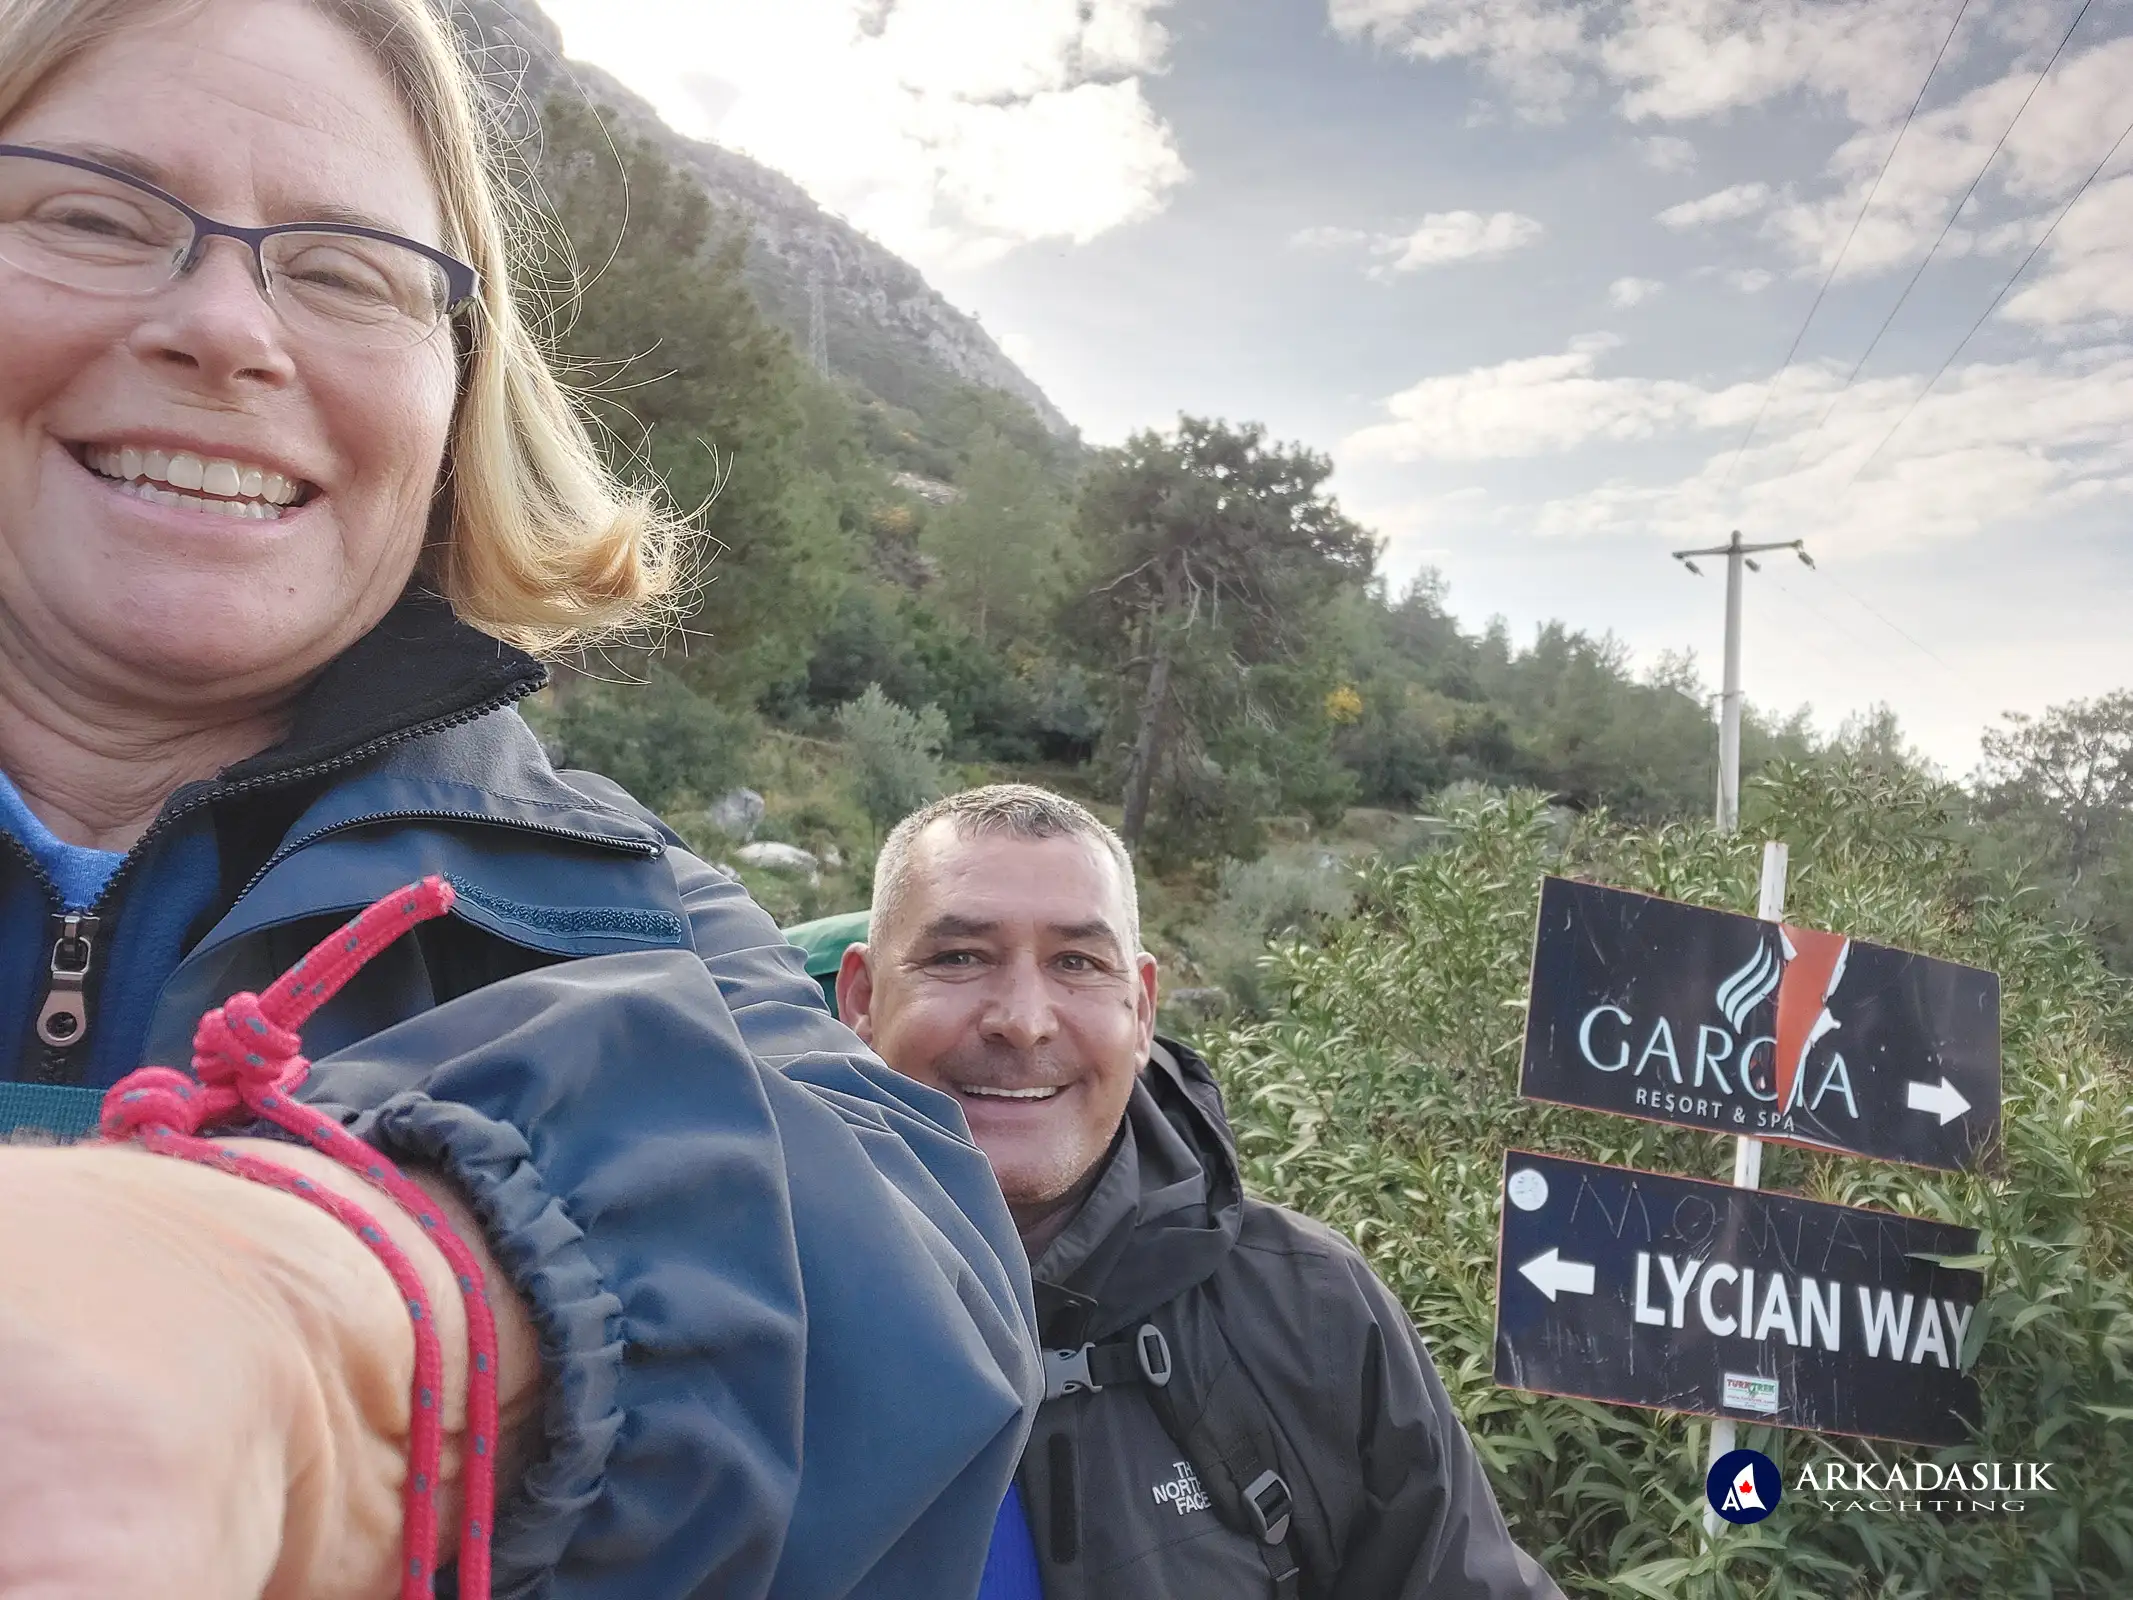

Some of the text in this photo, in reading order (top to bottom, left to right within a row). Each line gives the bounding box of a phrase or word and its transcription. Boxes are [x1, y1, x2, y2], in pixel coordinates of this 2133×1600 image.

[1578, 1004, 1860, 1120] GARCIA
[1634, 1087, 1796, 1133] RESORT & SPA
[1634, 1251, 1975, 1371] LYCIAN WAY
[1172, 1460, 1194, 1480] TH
[1174, 1491, 1213, 1516] FACE
